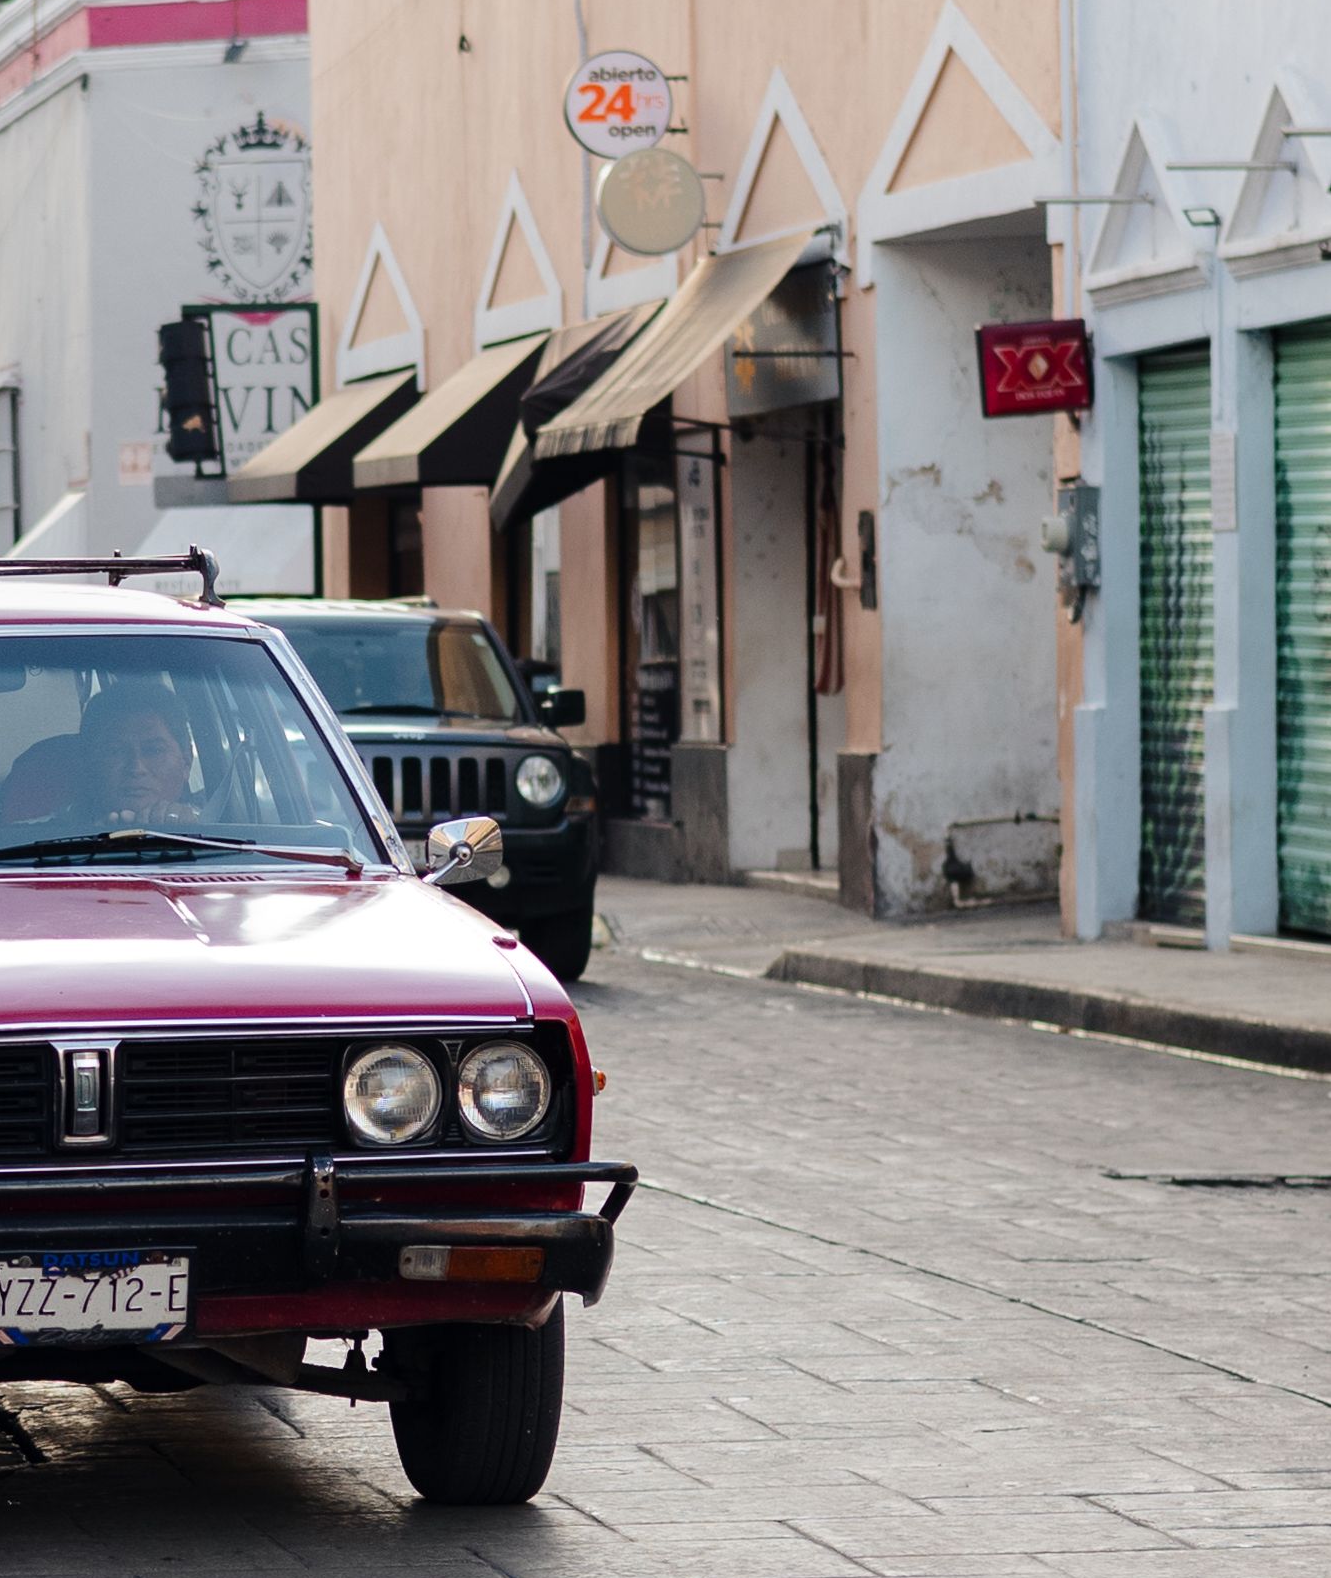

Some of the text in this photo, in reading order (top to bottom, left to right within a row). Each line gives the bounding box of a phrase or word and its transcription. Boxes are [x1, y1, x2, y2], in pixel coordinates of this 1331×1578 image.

[588, 68, 657, 82] abierto
[577, 83, 665, 123] 24 hrs
[608, 125, 657, 140] open
[42, 1251, 139, 1268] DATSUN
